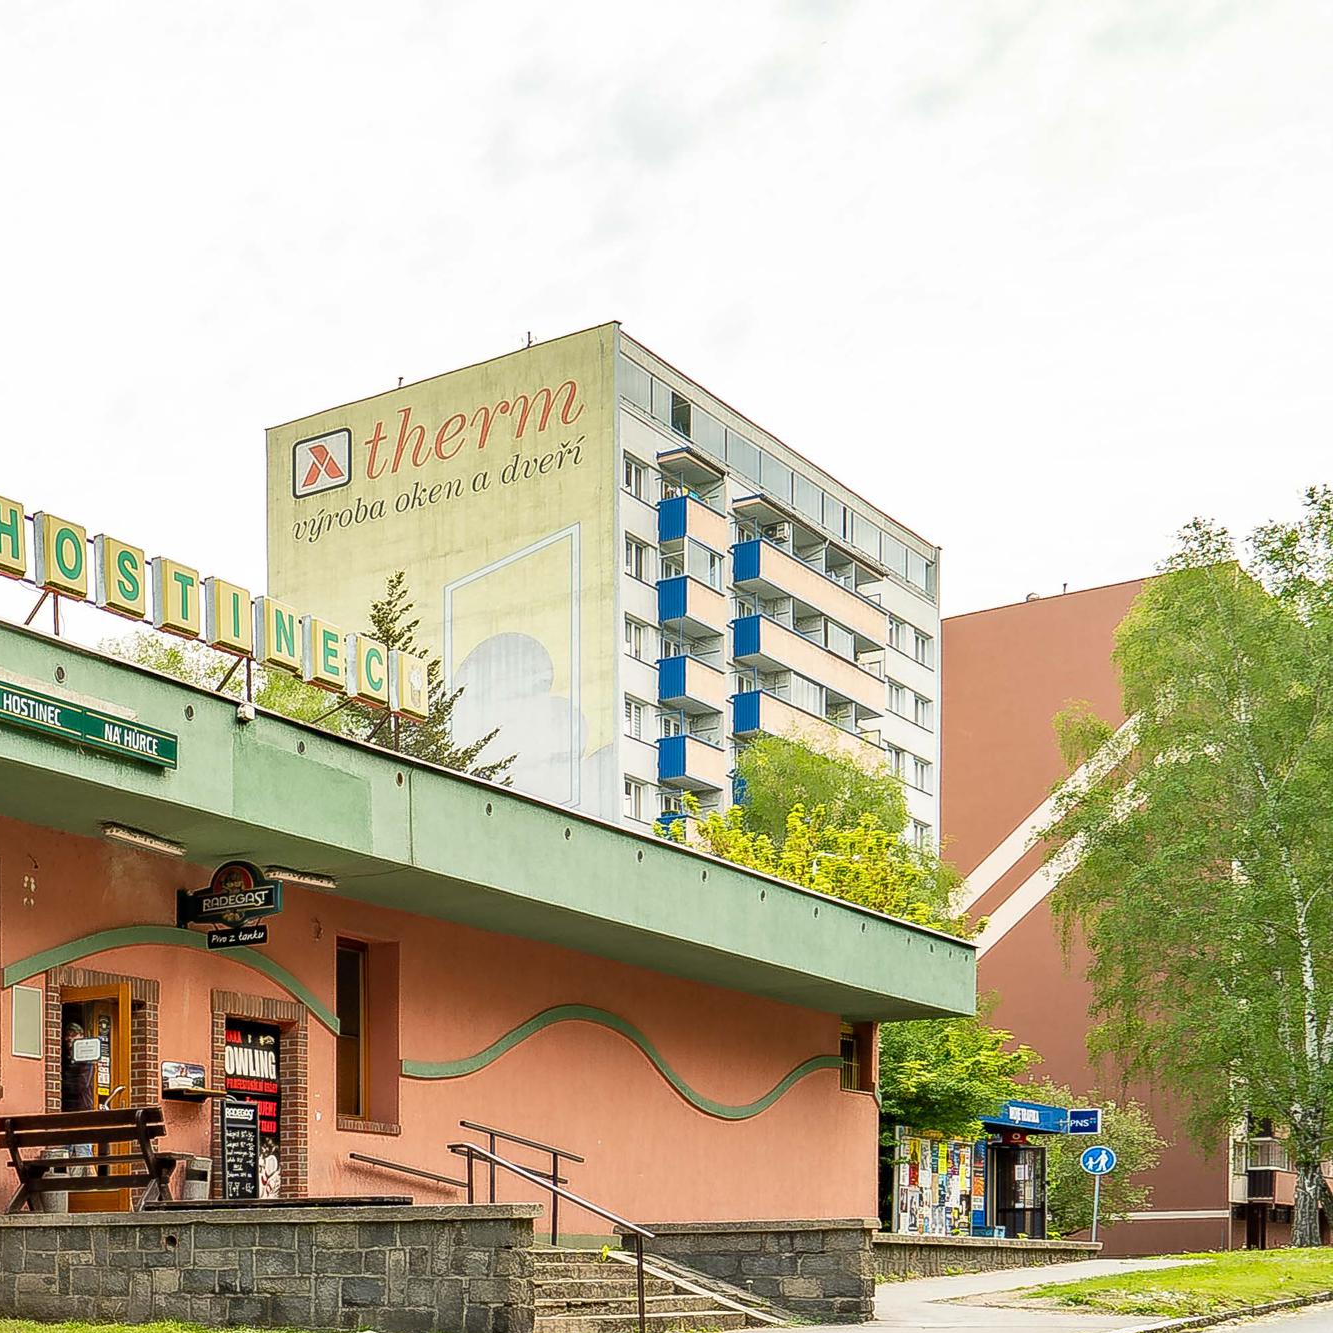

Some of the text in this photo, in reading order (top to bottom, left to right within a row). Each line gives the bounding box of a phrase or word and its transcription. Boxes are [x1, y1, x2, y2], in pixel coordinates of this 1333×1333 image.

[364, 379, 585, 480] therm
[292, 435, 586, 543] výroba oken a dveří
[3, 692, 62, 726] HOSTINEC
[203, 890, 269, 912] RADEGAST
[211, 934, 228, 943] Pivo
[238, 931, 265, 942] tanku
[224, 1045, 277, 1080] OWLING
[1069, 1119, 1090, 1128] PNS
